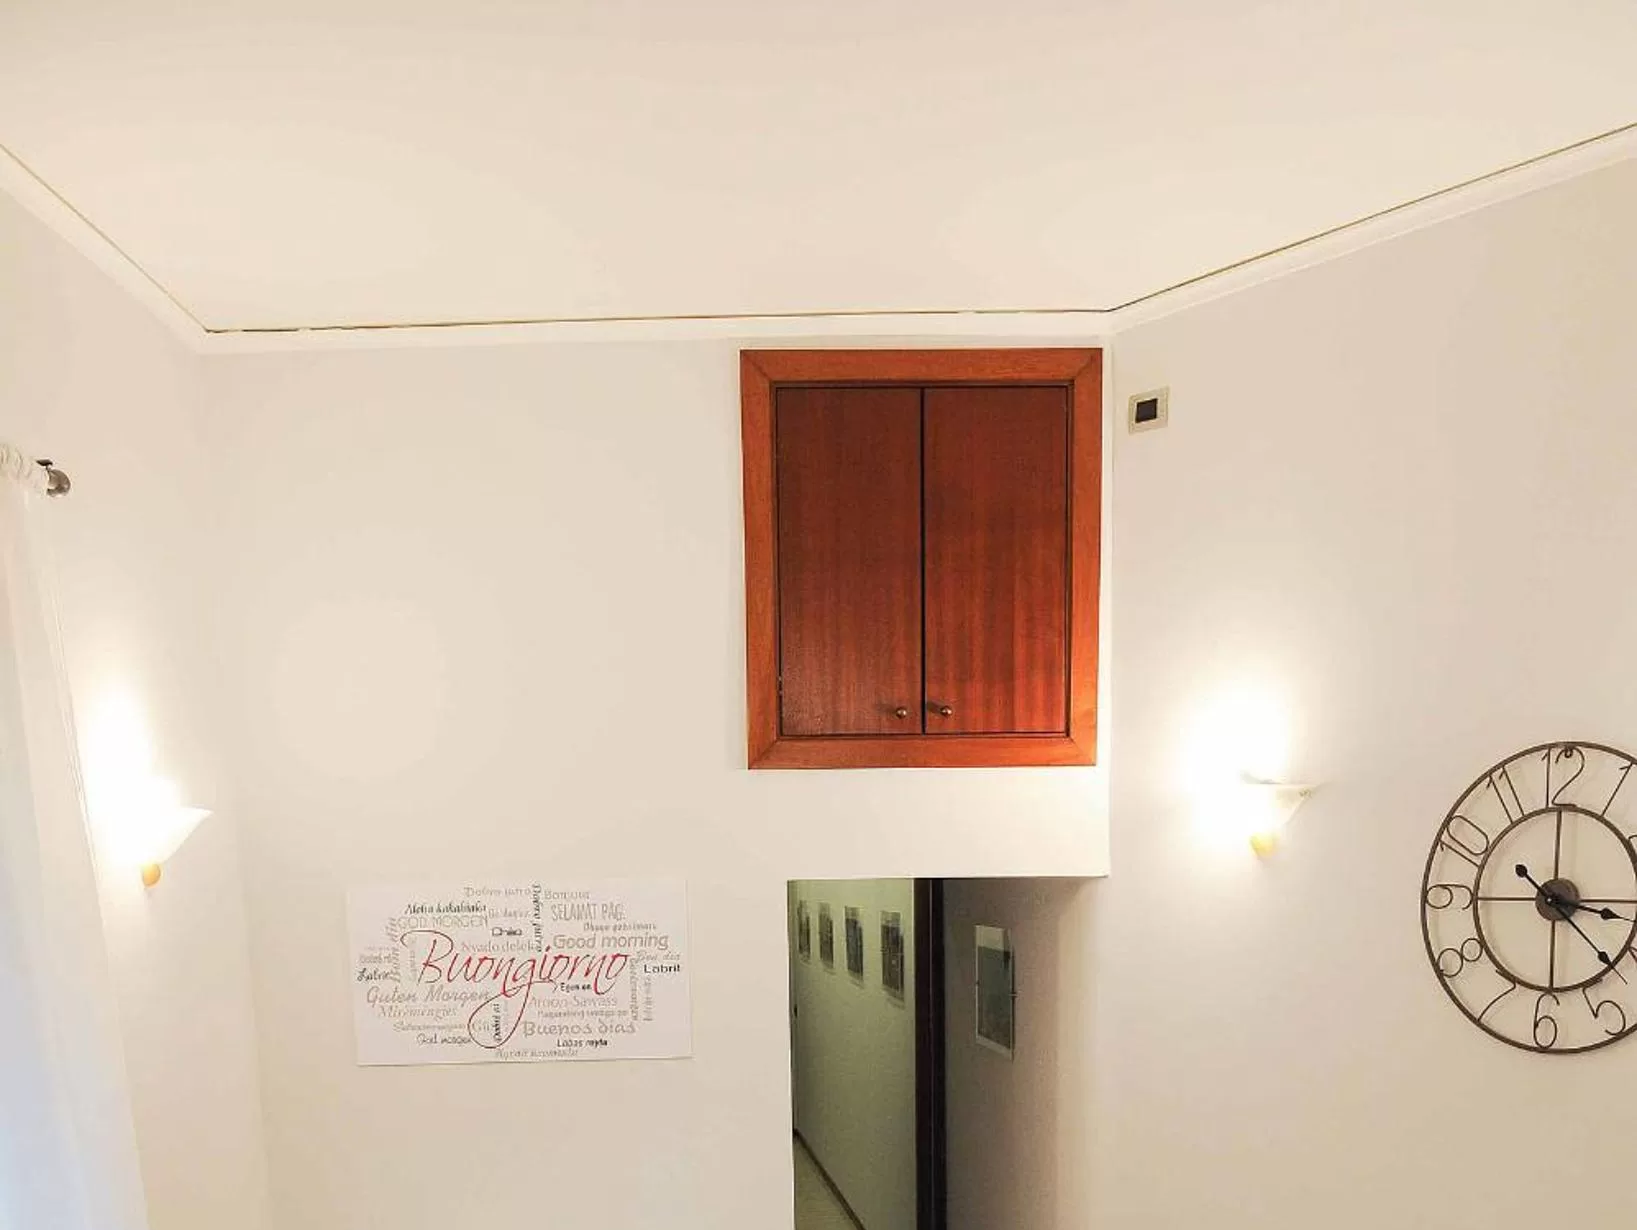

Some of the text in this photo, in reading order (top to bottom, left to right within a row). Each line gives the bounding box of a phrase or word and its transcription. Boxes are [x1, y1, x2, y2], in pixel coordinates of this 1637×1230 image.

[1486, 765, 1525, 824] 11
[1541, 744, 1586, 810] 12
[1438, 814, 1490, 868] 10
[553, 933, 669, 950] Good morning
[366, 985, 490, 1008] Guten Morgen
[400, 929, 629, 1049] Buongiorno
[522, 1022, 592, 1038] Buenos
[1533, 991, 1561, 1049] 6
